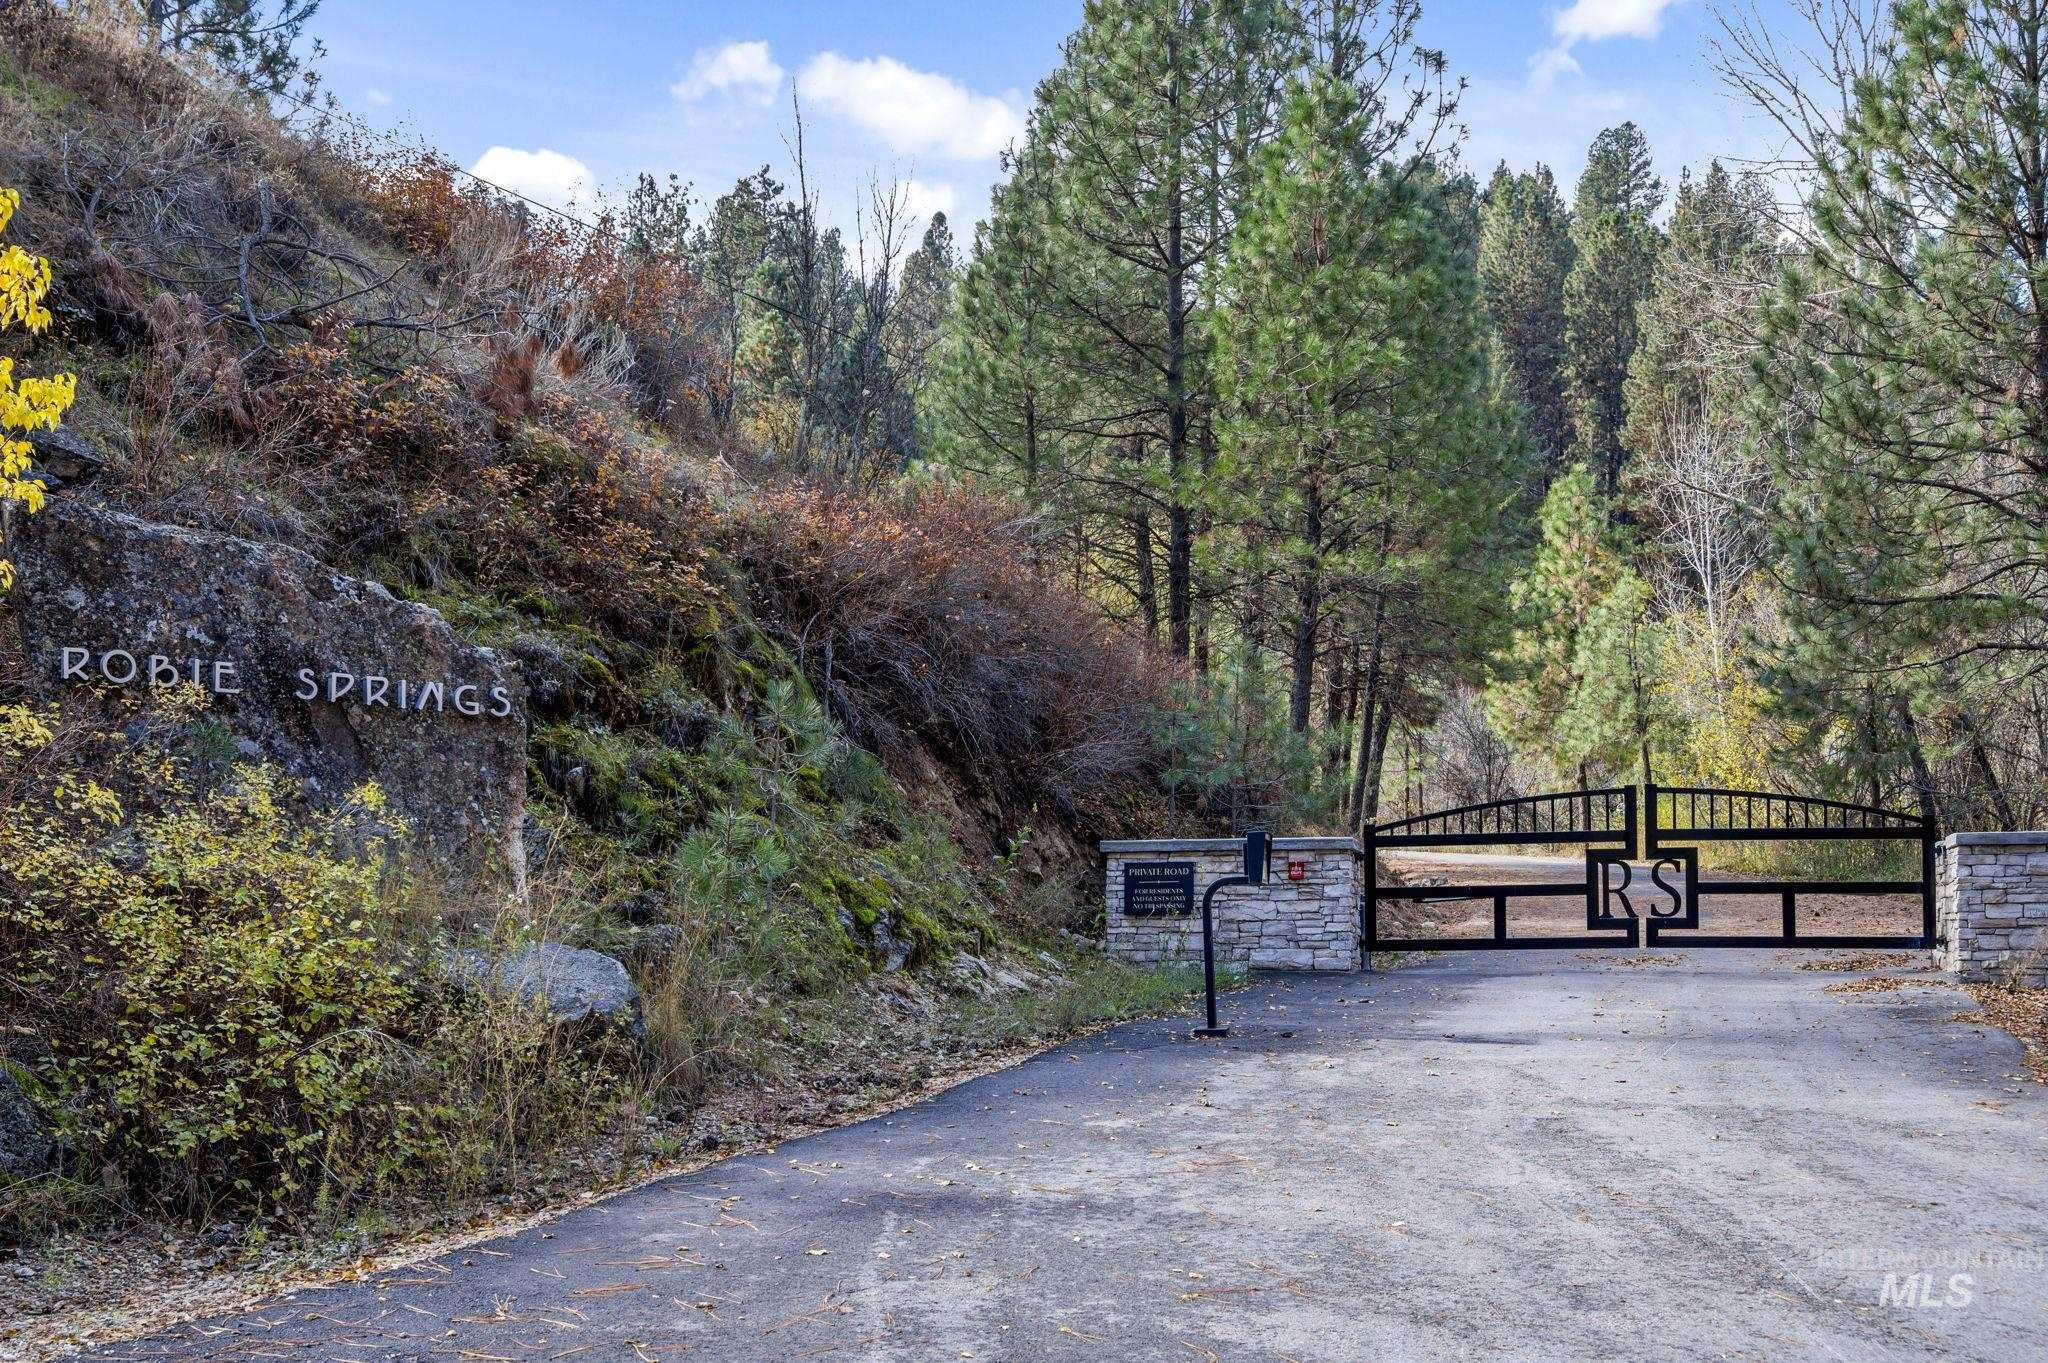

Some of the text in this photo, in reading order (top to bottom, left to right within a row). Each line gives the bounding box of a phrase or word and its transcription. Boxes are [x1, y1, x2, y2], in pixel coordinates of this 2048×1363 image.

[61, 647, 512, 717] ROBIE SPRINGS
[1129, 868, 1189, 876] PRIVATE ROAD
